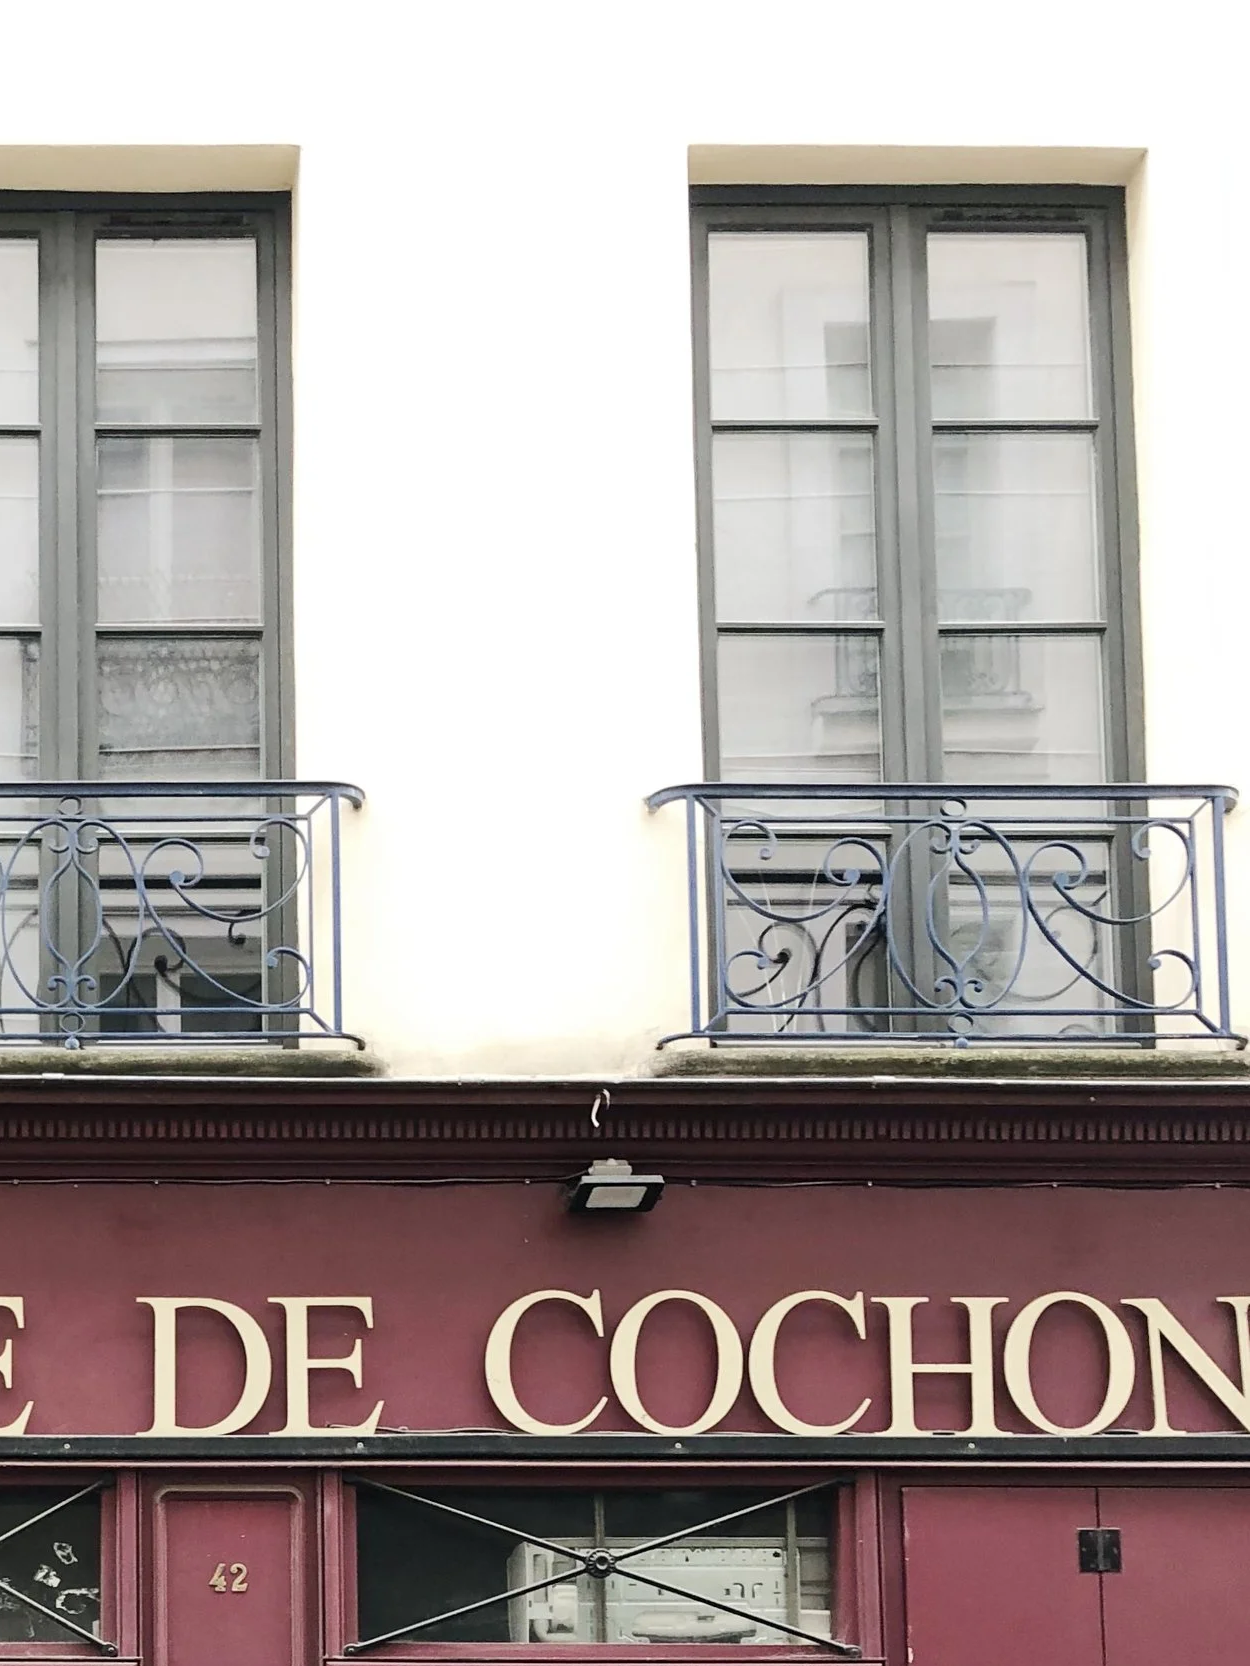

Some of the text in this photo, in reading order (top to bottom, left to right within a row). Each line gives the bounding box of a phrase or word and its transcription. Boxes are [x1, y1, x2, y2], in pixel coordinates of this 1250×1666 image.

[135, 1296, 386, 1437] DE
[485, 1289, 1250, 1437] COCHON
[208, 1563, 248, 1592] 42
